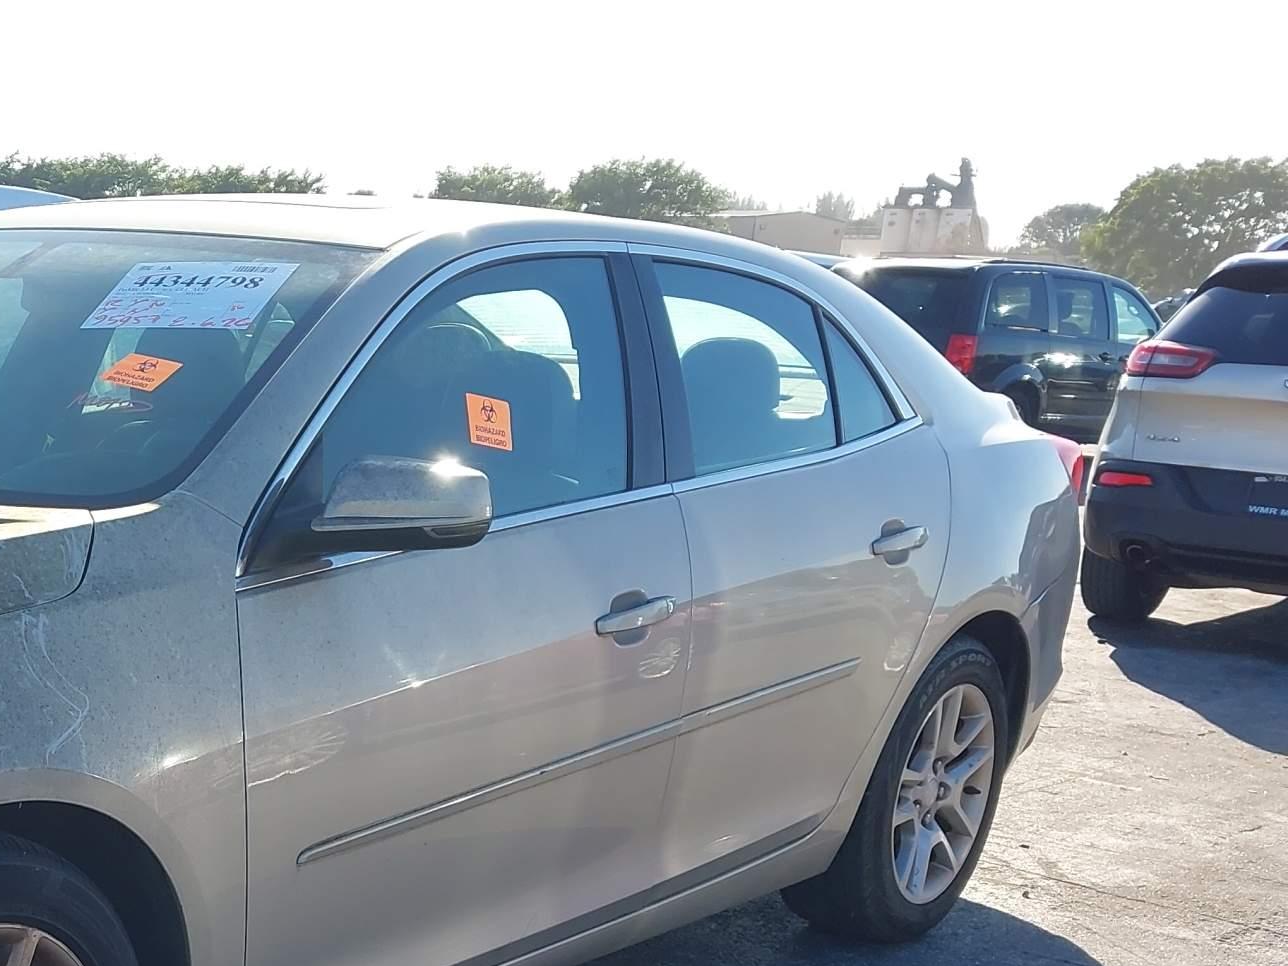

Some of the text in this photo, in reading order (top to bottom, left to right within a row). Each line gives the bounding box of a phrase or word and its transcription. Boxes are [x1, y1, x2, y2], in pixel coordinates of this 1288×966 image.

[134, 275, 264, 289] 44344798
[475, 424, 506, 437] BIOHAZARD
[1248, 505, 1279, 516] WMR
